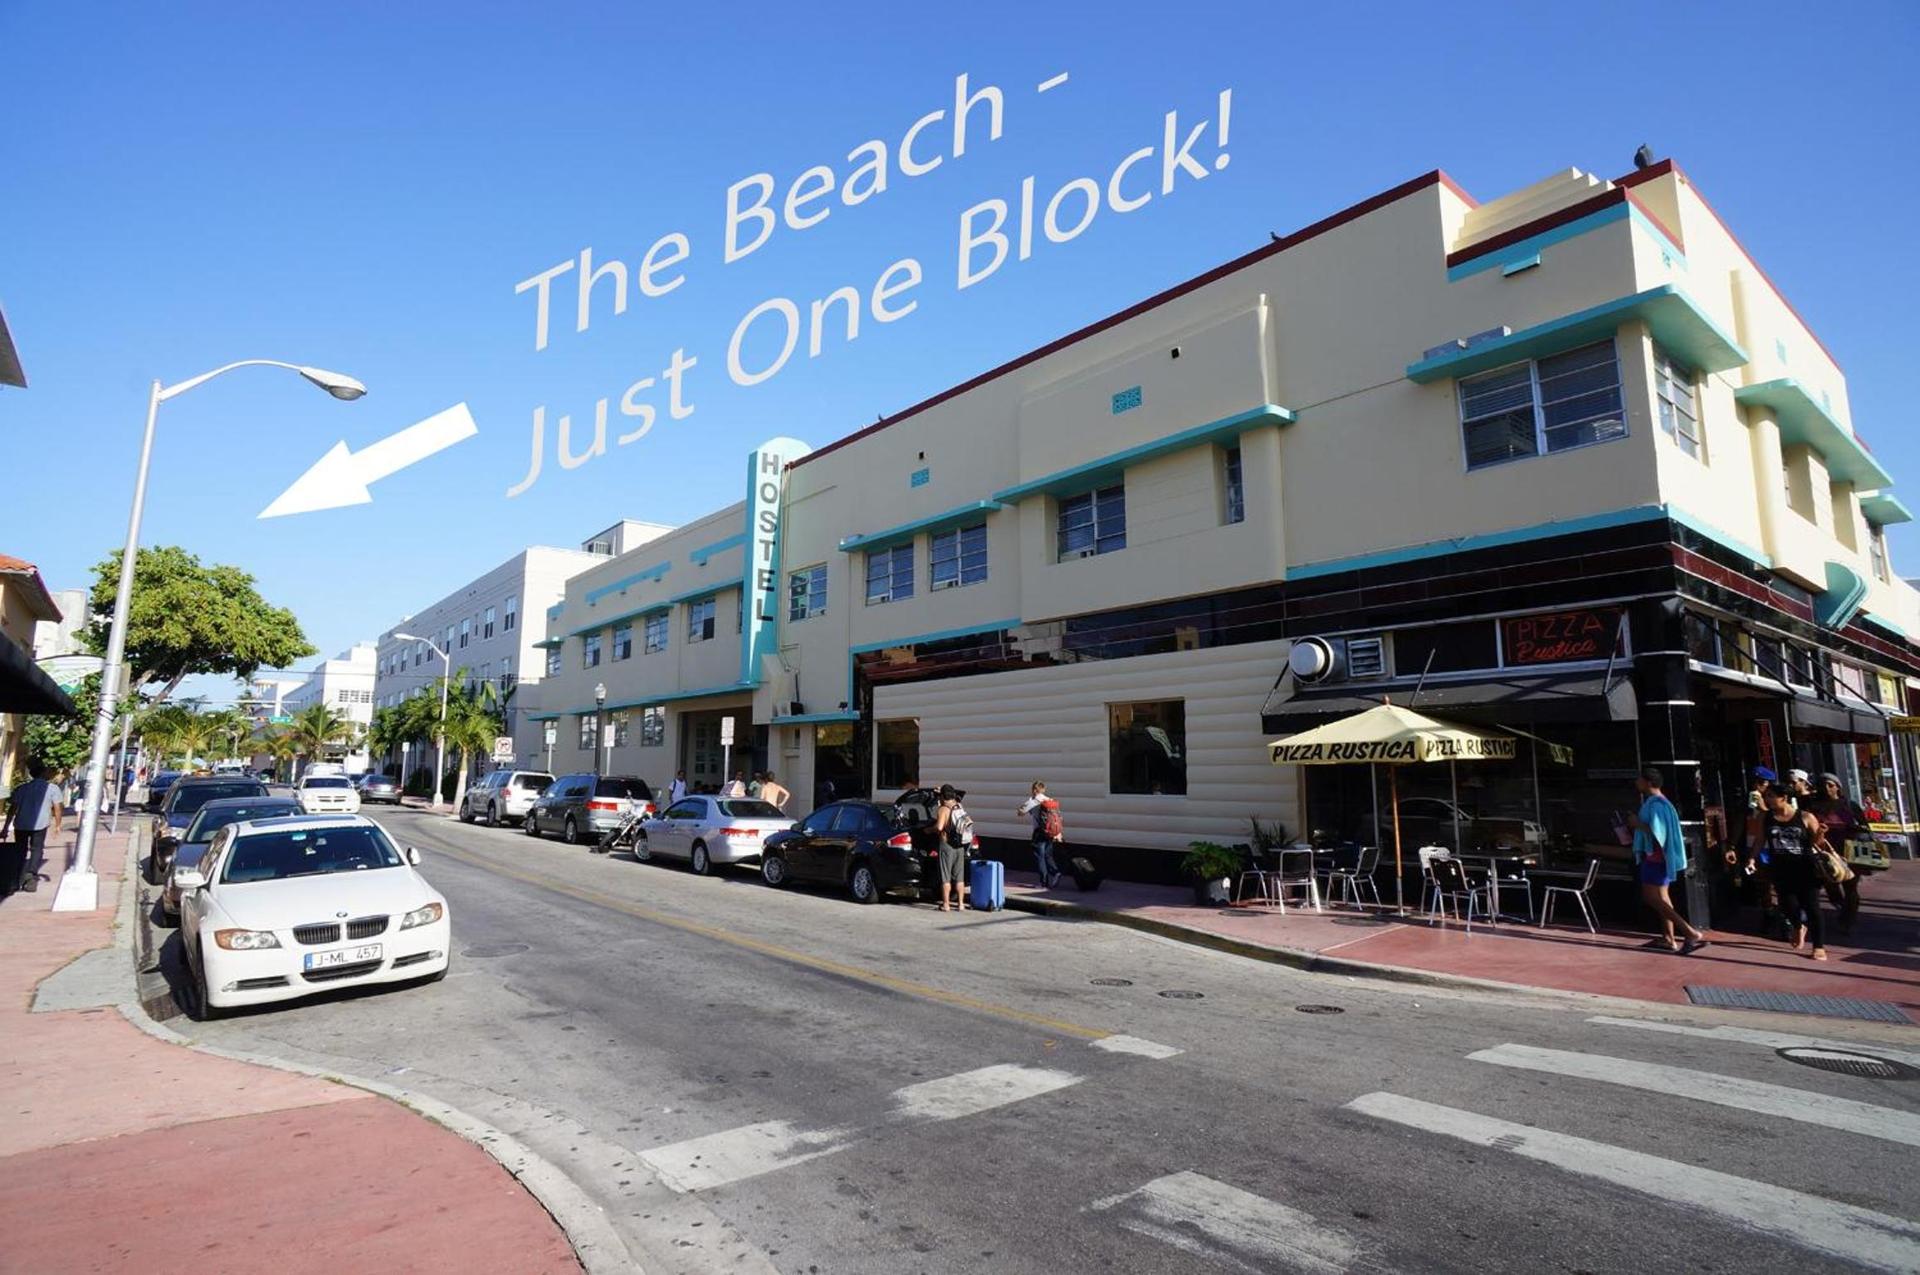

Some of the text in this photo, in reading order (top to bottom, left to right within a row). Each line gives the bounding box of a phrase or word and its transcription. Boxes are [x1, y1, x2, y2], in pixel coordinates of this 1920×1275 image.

[756, 451, 780, 622] HOSTEL
[1518, 611, 1604, 640] PIZZA
[1515, 639, 1597, 663] Rustica
[1272, 741, 1416, 762] PIZZA RUSTICA
[1426, 739, 1463, 758] PIZZA
[357, 946, 378, 959] 457
